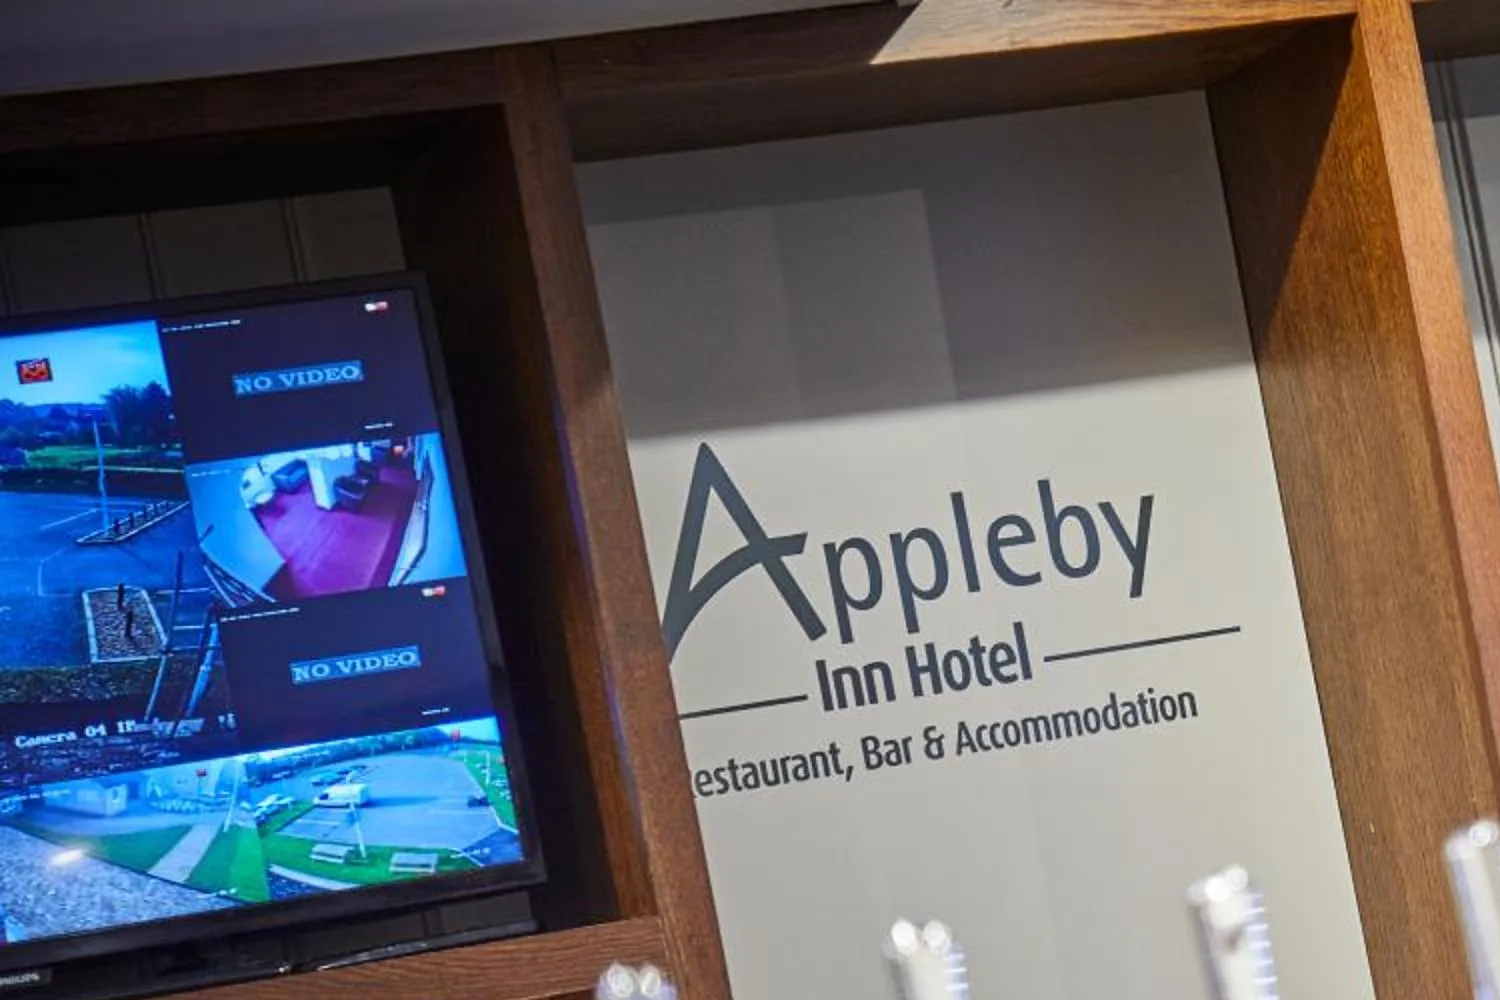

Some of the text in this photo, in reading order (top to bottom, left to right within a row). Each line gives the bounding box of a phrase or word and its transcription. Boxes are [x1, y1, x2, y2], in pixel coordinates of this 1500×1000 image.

[234, 364, 360, 394] NO VIDEO
[661, 442, 1154, 665] Appleby
[292, 650, 419, 682] NO VIDEO
[814, 621, 1033, 712] Inn Hotel
[692, 686, 1199, 798] estaurant, Bar & Accommodation
